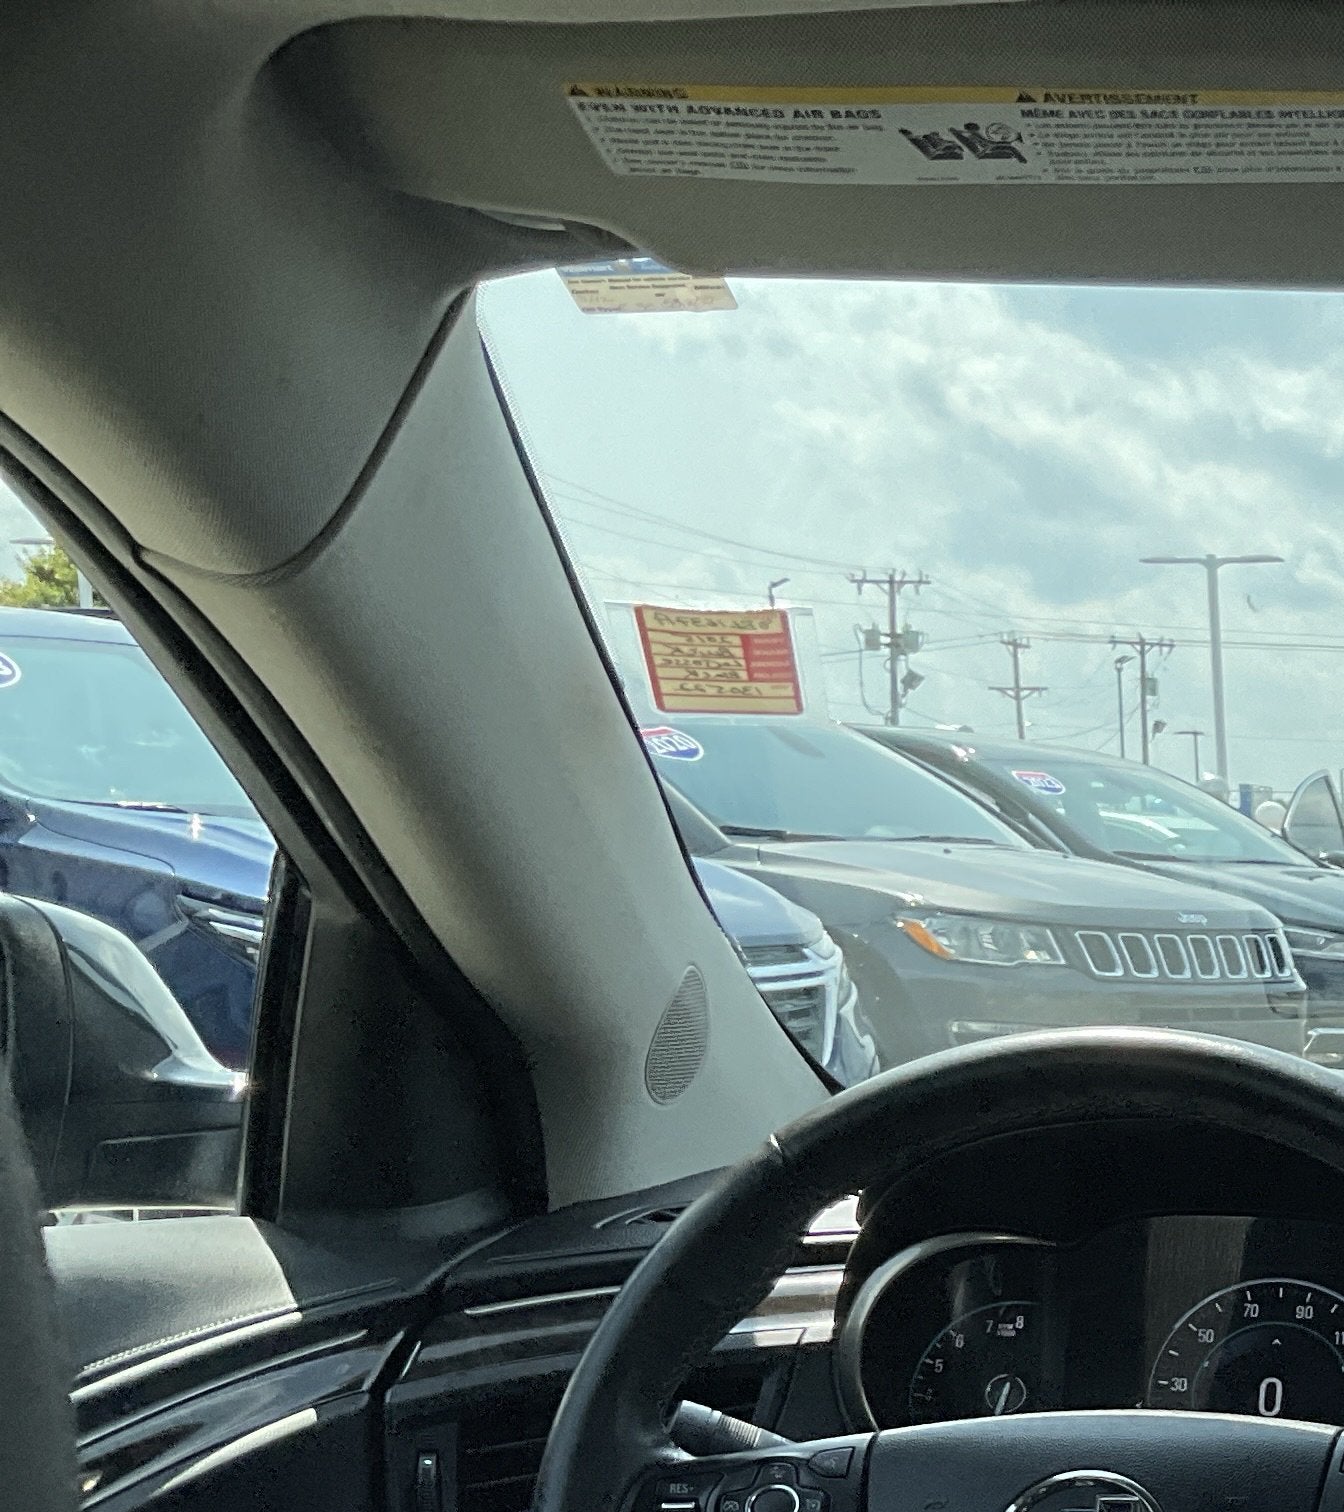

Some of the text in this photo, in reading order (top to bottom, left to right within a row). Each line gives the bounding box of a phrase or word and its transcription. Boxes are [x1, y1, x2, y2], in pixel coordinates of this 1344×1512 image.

[1243, 1302, 1260, 1318] 70
[1295, 1305, 1314, 1320] 90
[1197, 1328, 1215, 1344] 50
[934, 1358, 944, 1373] 5
[1169, 1377, 1188, 1393] 30
[1258, 1376, 1283, 1417] 0
